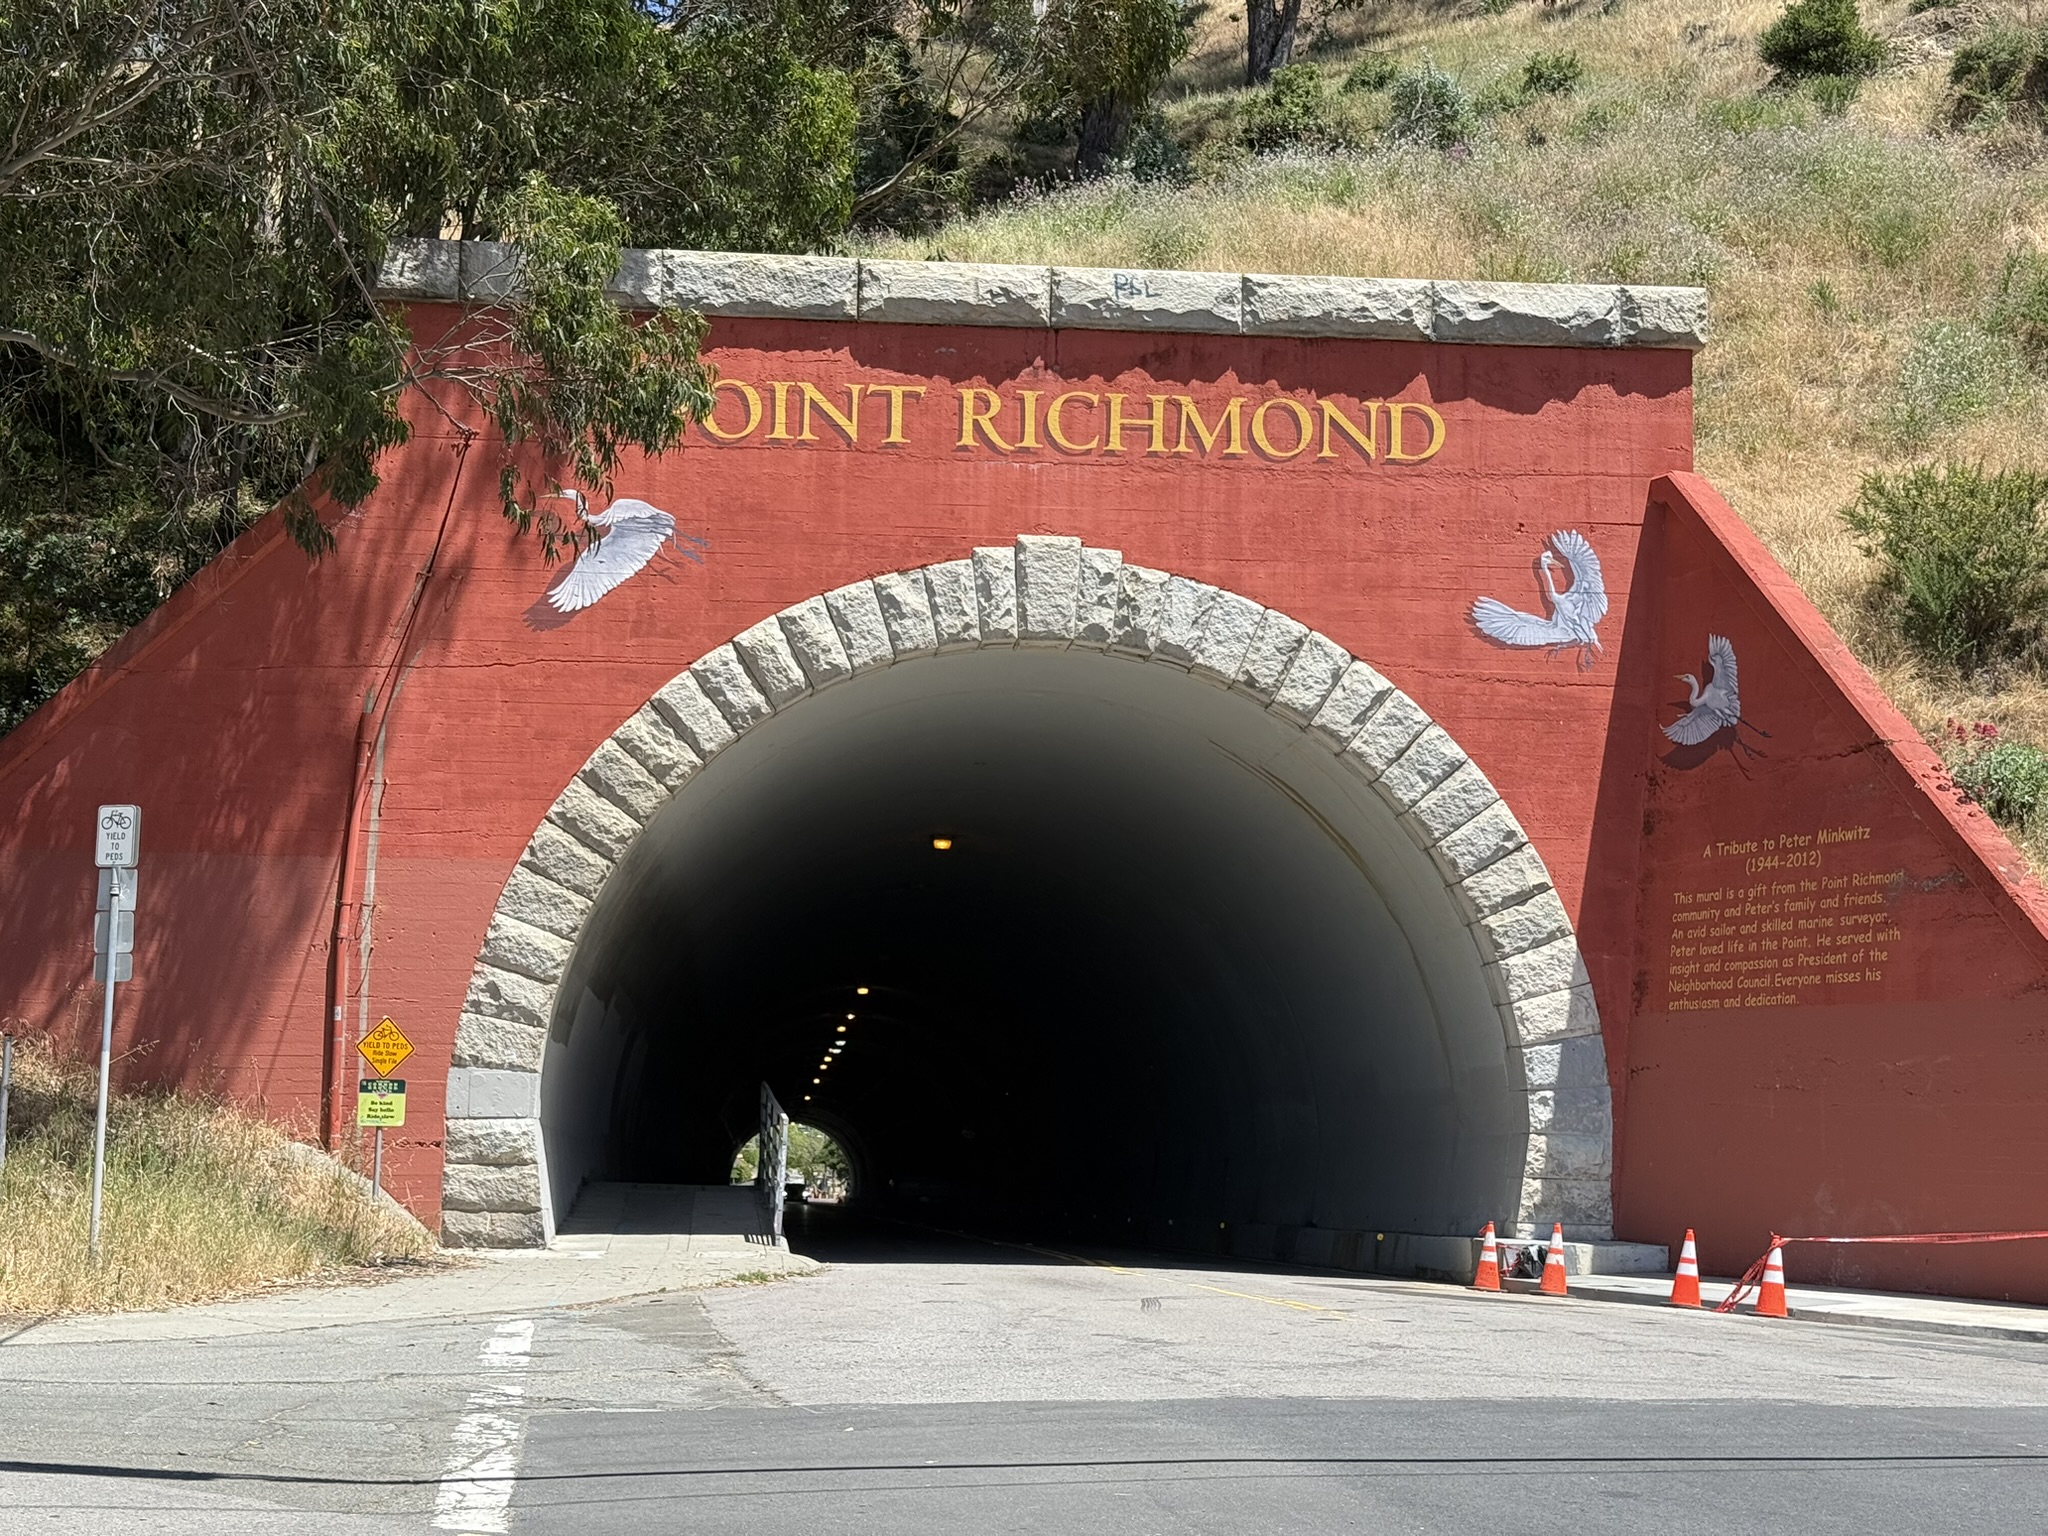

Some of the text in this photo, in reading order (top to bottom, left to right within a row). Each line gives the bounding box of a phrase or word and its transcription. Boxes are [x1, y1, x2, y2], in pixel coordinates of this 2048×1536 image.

[674, 378, 1447, 462] OINT RICHMOND
[106, 832, 125, 840] YIELD
[111, 842, 119, 850] TO
[1703, 826, 1870, 858] A Tribute to Peter Minkwitz
[1746, 850, 1821, 875] (1944-2012)
[1674, 869, 1904, 904] This mural is a gift from the Point Richmond
[1672, 890, 1886, 922] community and Peter's family and friends.
[1671, 929, 1683, 939] An
[1687, 925, 1706, 938] avid
[1710, 923, 1736, 936] sailor
[1740, 920, 1758, 934] and
[1762, 917, 1793, 933] skilled
[1798, 915, 1833, 929] marine
[1670, 927, 1901, 957] Peter loved life in the Point. He served with
[1670, 948, 1888, 977] insight and compassion as President of the
[1669, 977, 1733, 995] Neighborhood
[1826, 970, 1860, 983] misses
[1866, 967, 1881, 981] his
[1669, 992, 1799, 1011] enthusiasm and dedication.
[372, 1057, 386, 1065] Single
